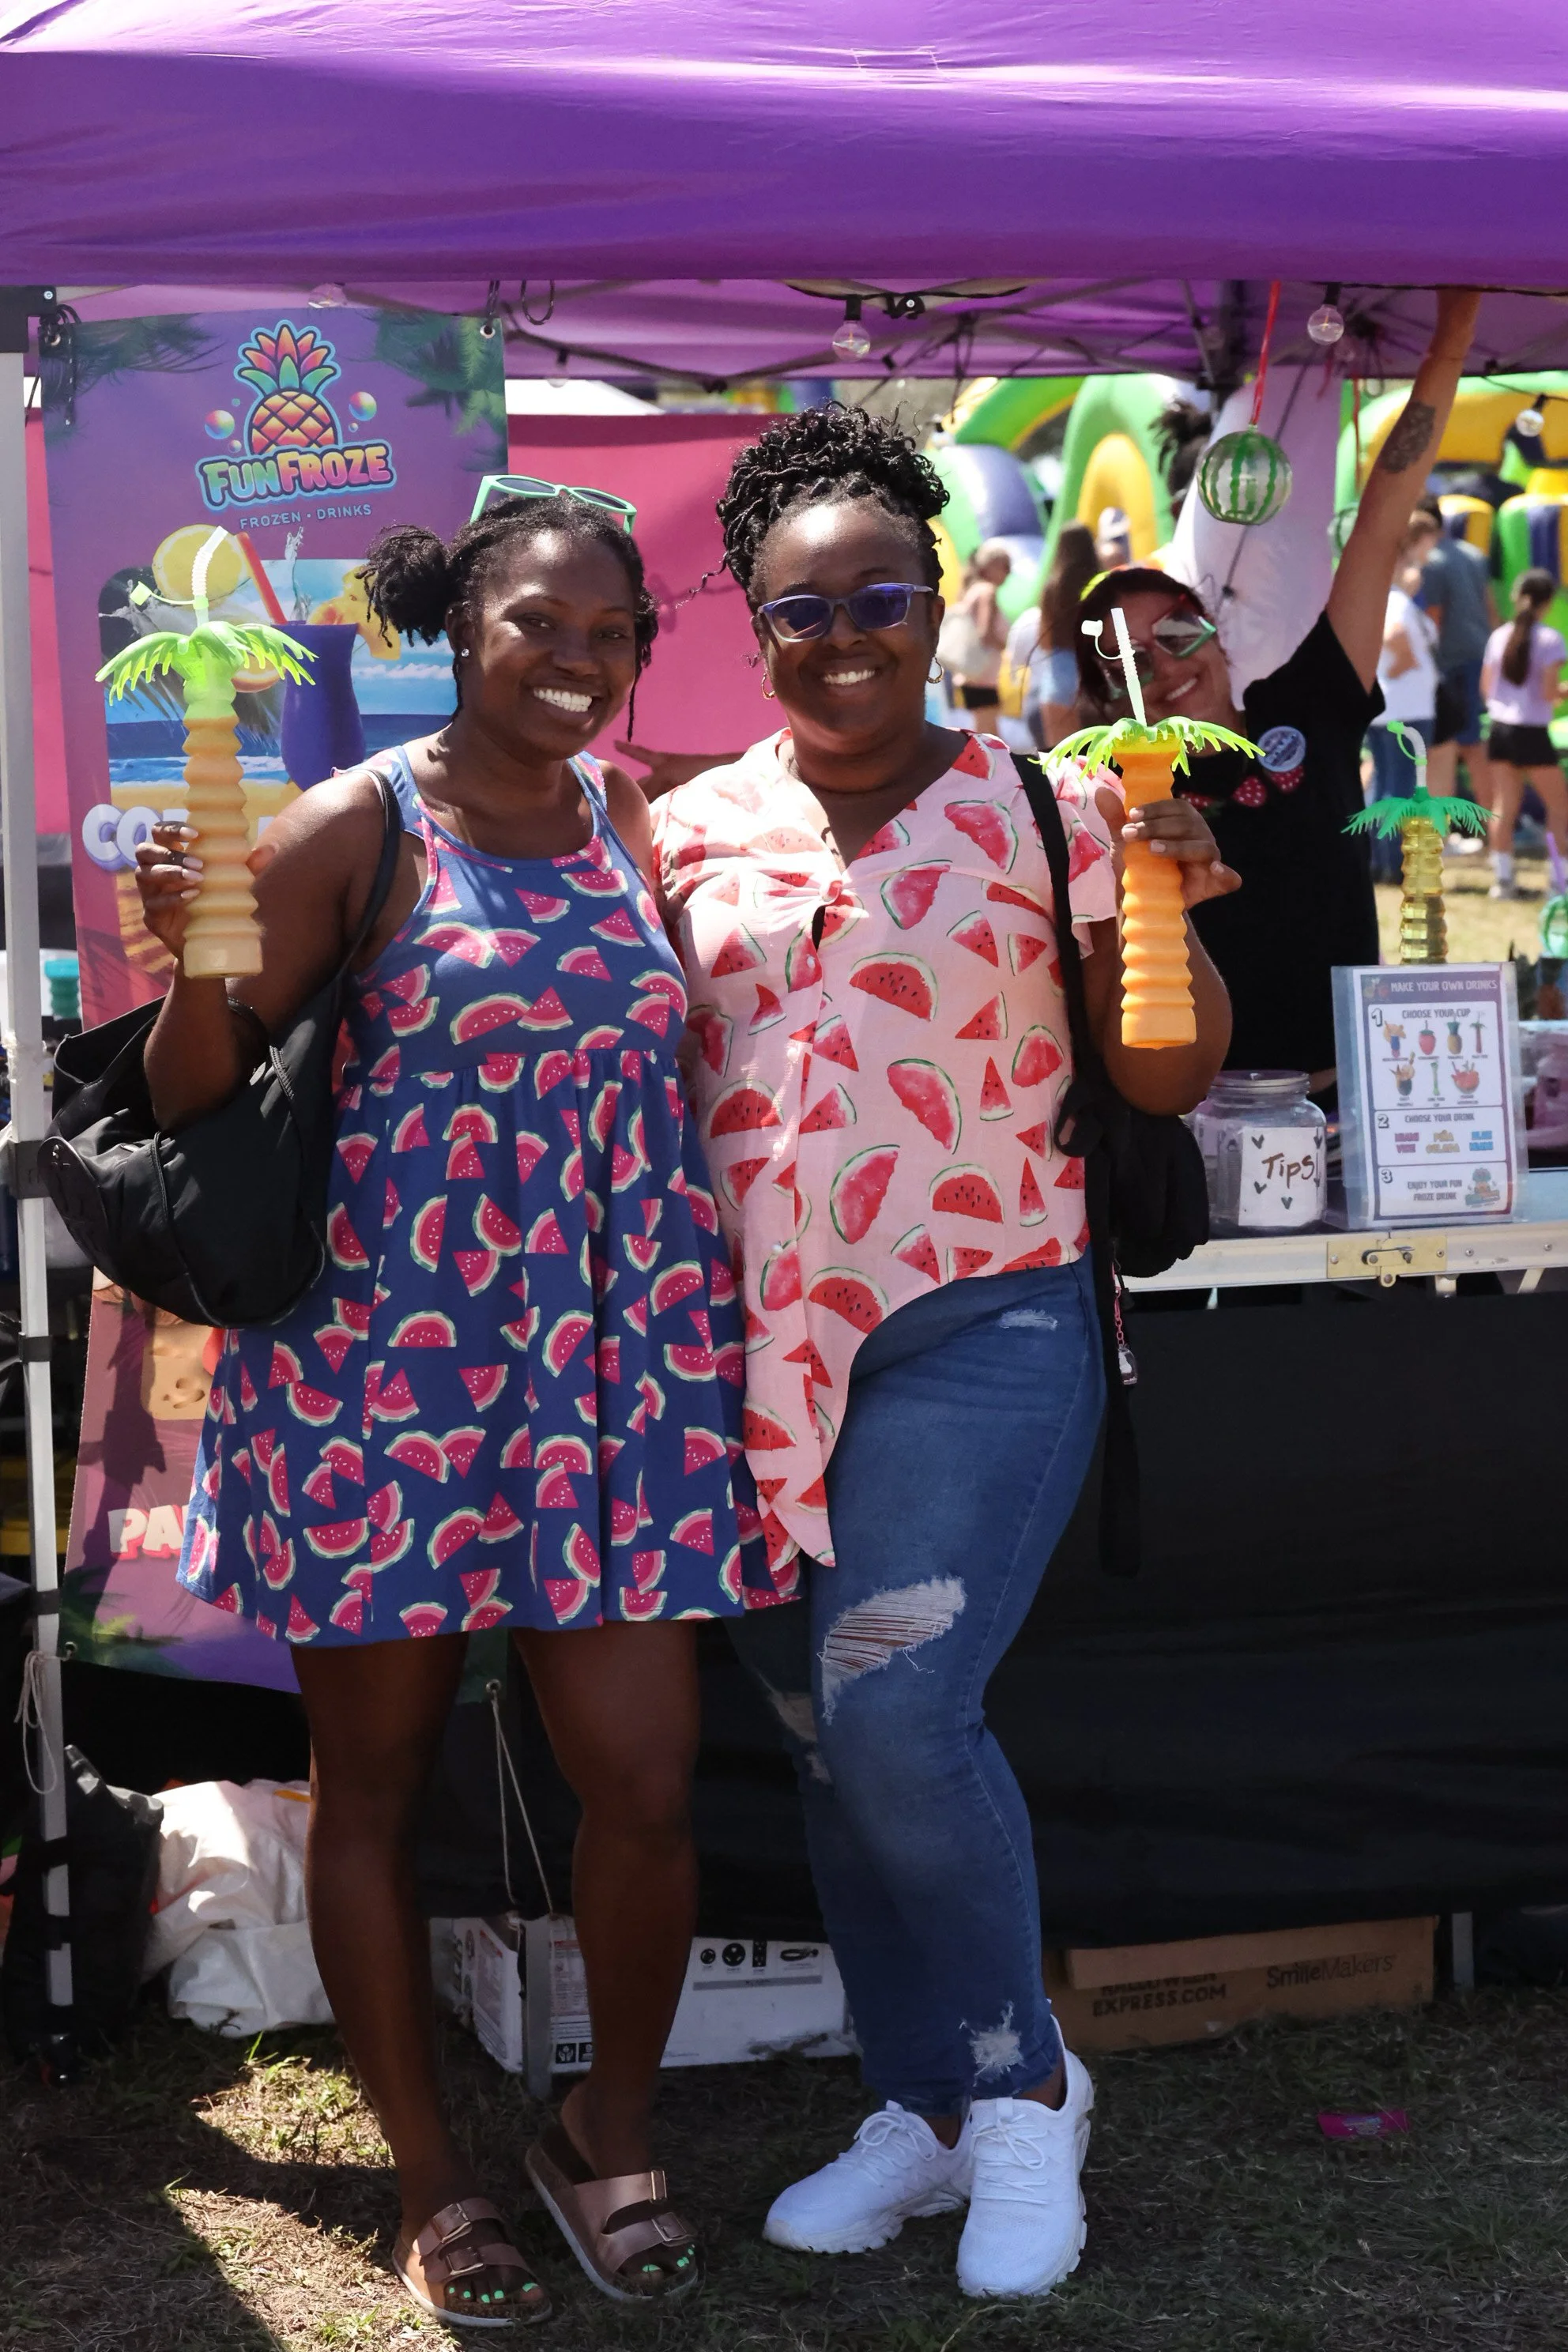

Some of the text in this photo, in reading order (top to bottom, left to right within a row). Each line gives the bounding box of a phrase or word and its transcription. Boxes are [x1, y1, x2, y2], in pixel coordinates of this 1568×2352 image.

[199, 443, 394, 507] FUNFROZE
[239, 503, 372, 530] FROZEN DRINKS
[1390, 979, 1498, 993] MAKE YOUR OWN DRINKS
[1371, 1007, 1383, 1027] 1
[1402, 1008, 1472, 1020] CHOOSE YOUR CUP
[1377, 1114, 1390, 1129] 2
[1404, 1114, 1432, 1124] CHOOSE
[1434, 1114, 1453, 1122] YOUR
[1261, 1152, 1315, 1189] Tips
[1381, 1169, 1393, 1184] 3
[1407, 1181, 1427, 1190] ENJOY
[1429, 1180, 1448, 1189] YOUR
[107, 1504, 189, 1561] PA
[1266, 1953, 1394, 1990] SmileMakers
[1092, 1982, 1227, 2018] EXPRESS.COM
